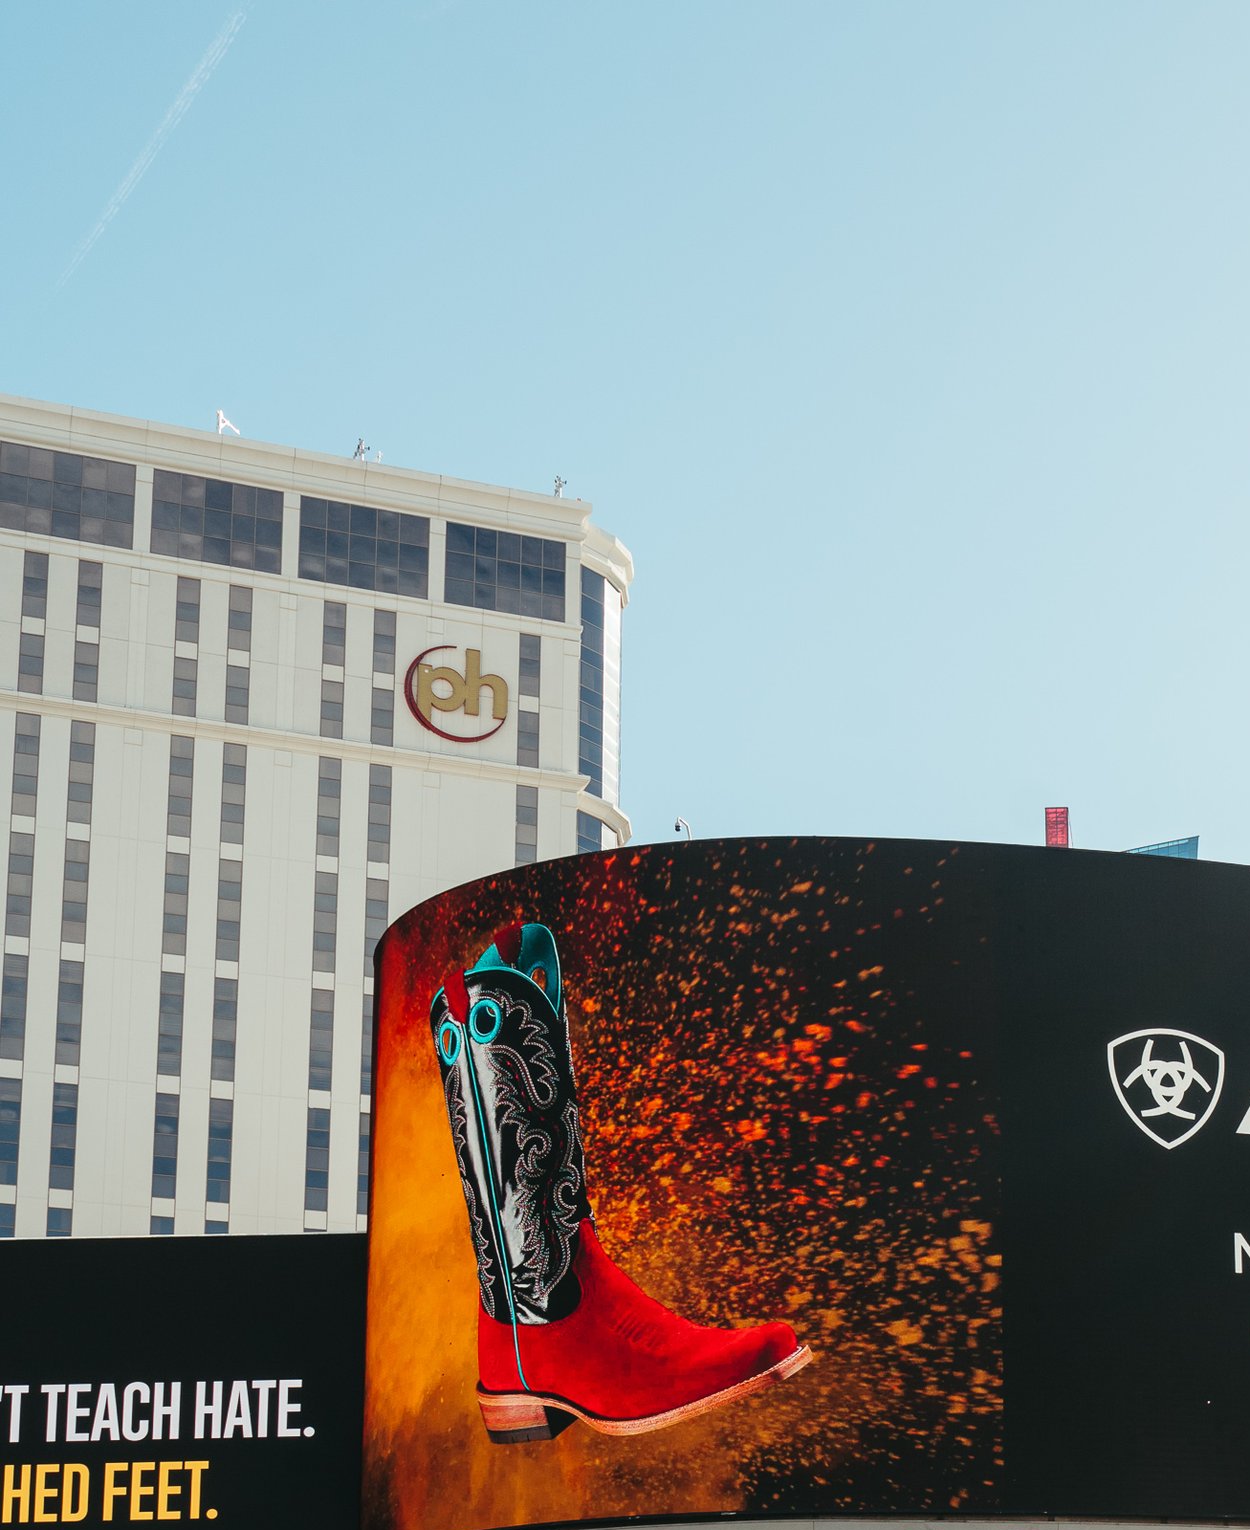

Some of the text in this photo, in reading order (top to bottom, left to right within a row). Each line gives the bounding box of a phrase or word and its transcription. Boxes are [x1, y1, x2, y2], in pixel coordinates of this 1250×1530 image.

[41, 1381, 182, 1443] TEACH
[194, 1379, 316, 1439] HATE.
[102, 1460, 218, 1522] FEET.
